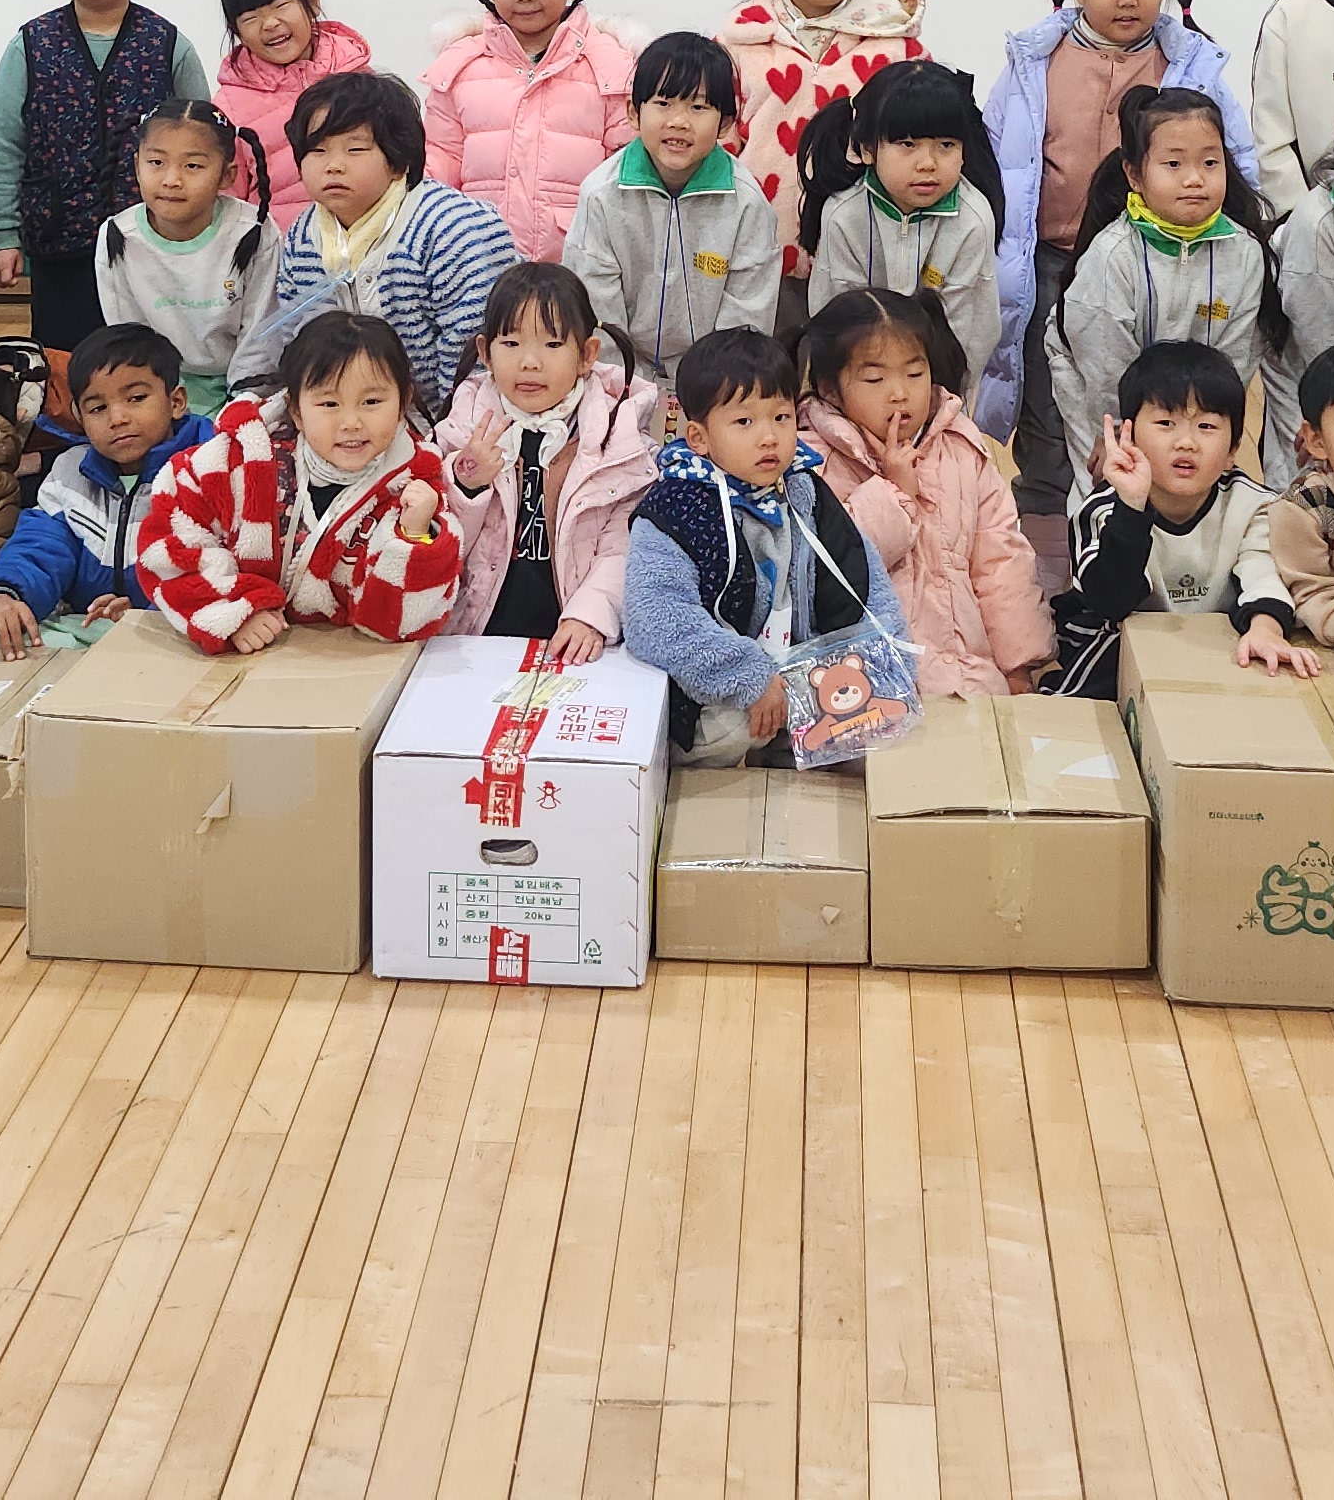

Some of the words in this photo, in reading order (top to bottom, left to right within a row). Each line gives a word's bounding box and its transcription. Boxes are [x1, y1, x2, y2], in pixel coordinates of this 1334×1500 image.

[555, 703, 593, 742] 취급주의
[491, 782, 513, 827] 급주의
[524, 911, 552, 922] 20kg
